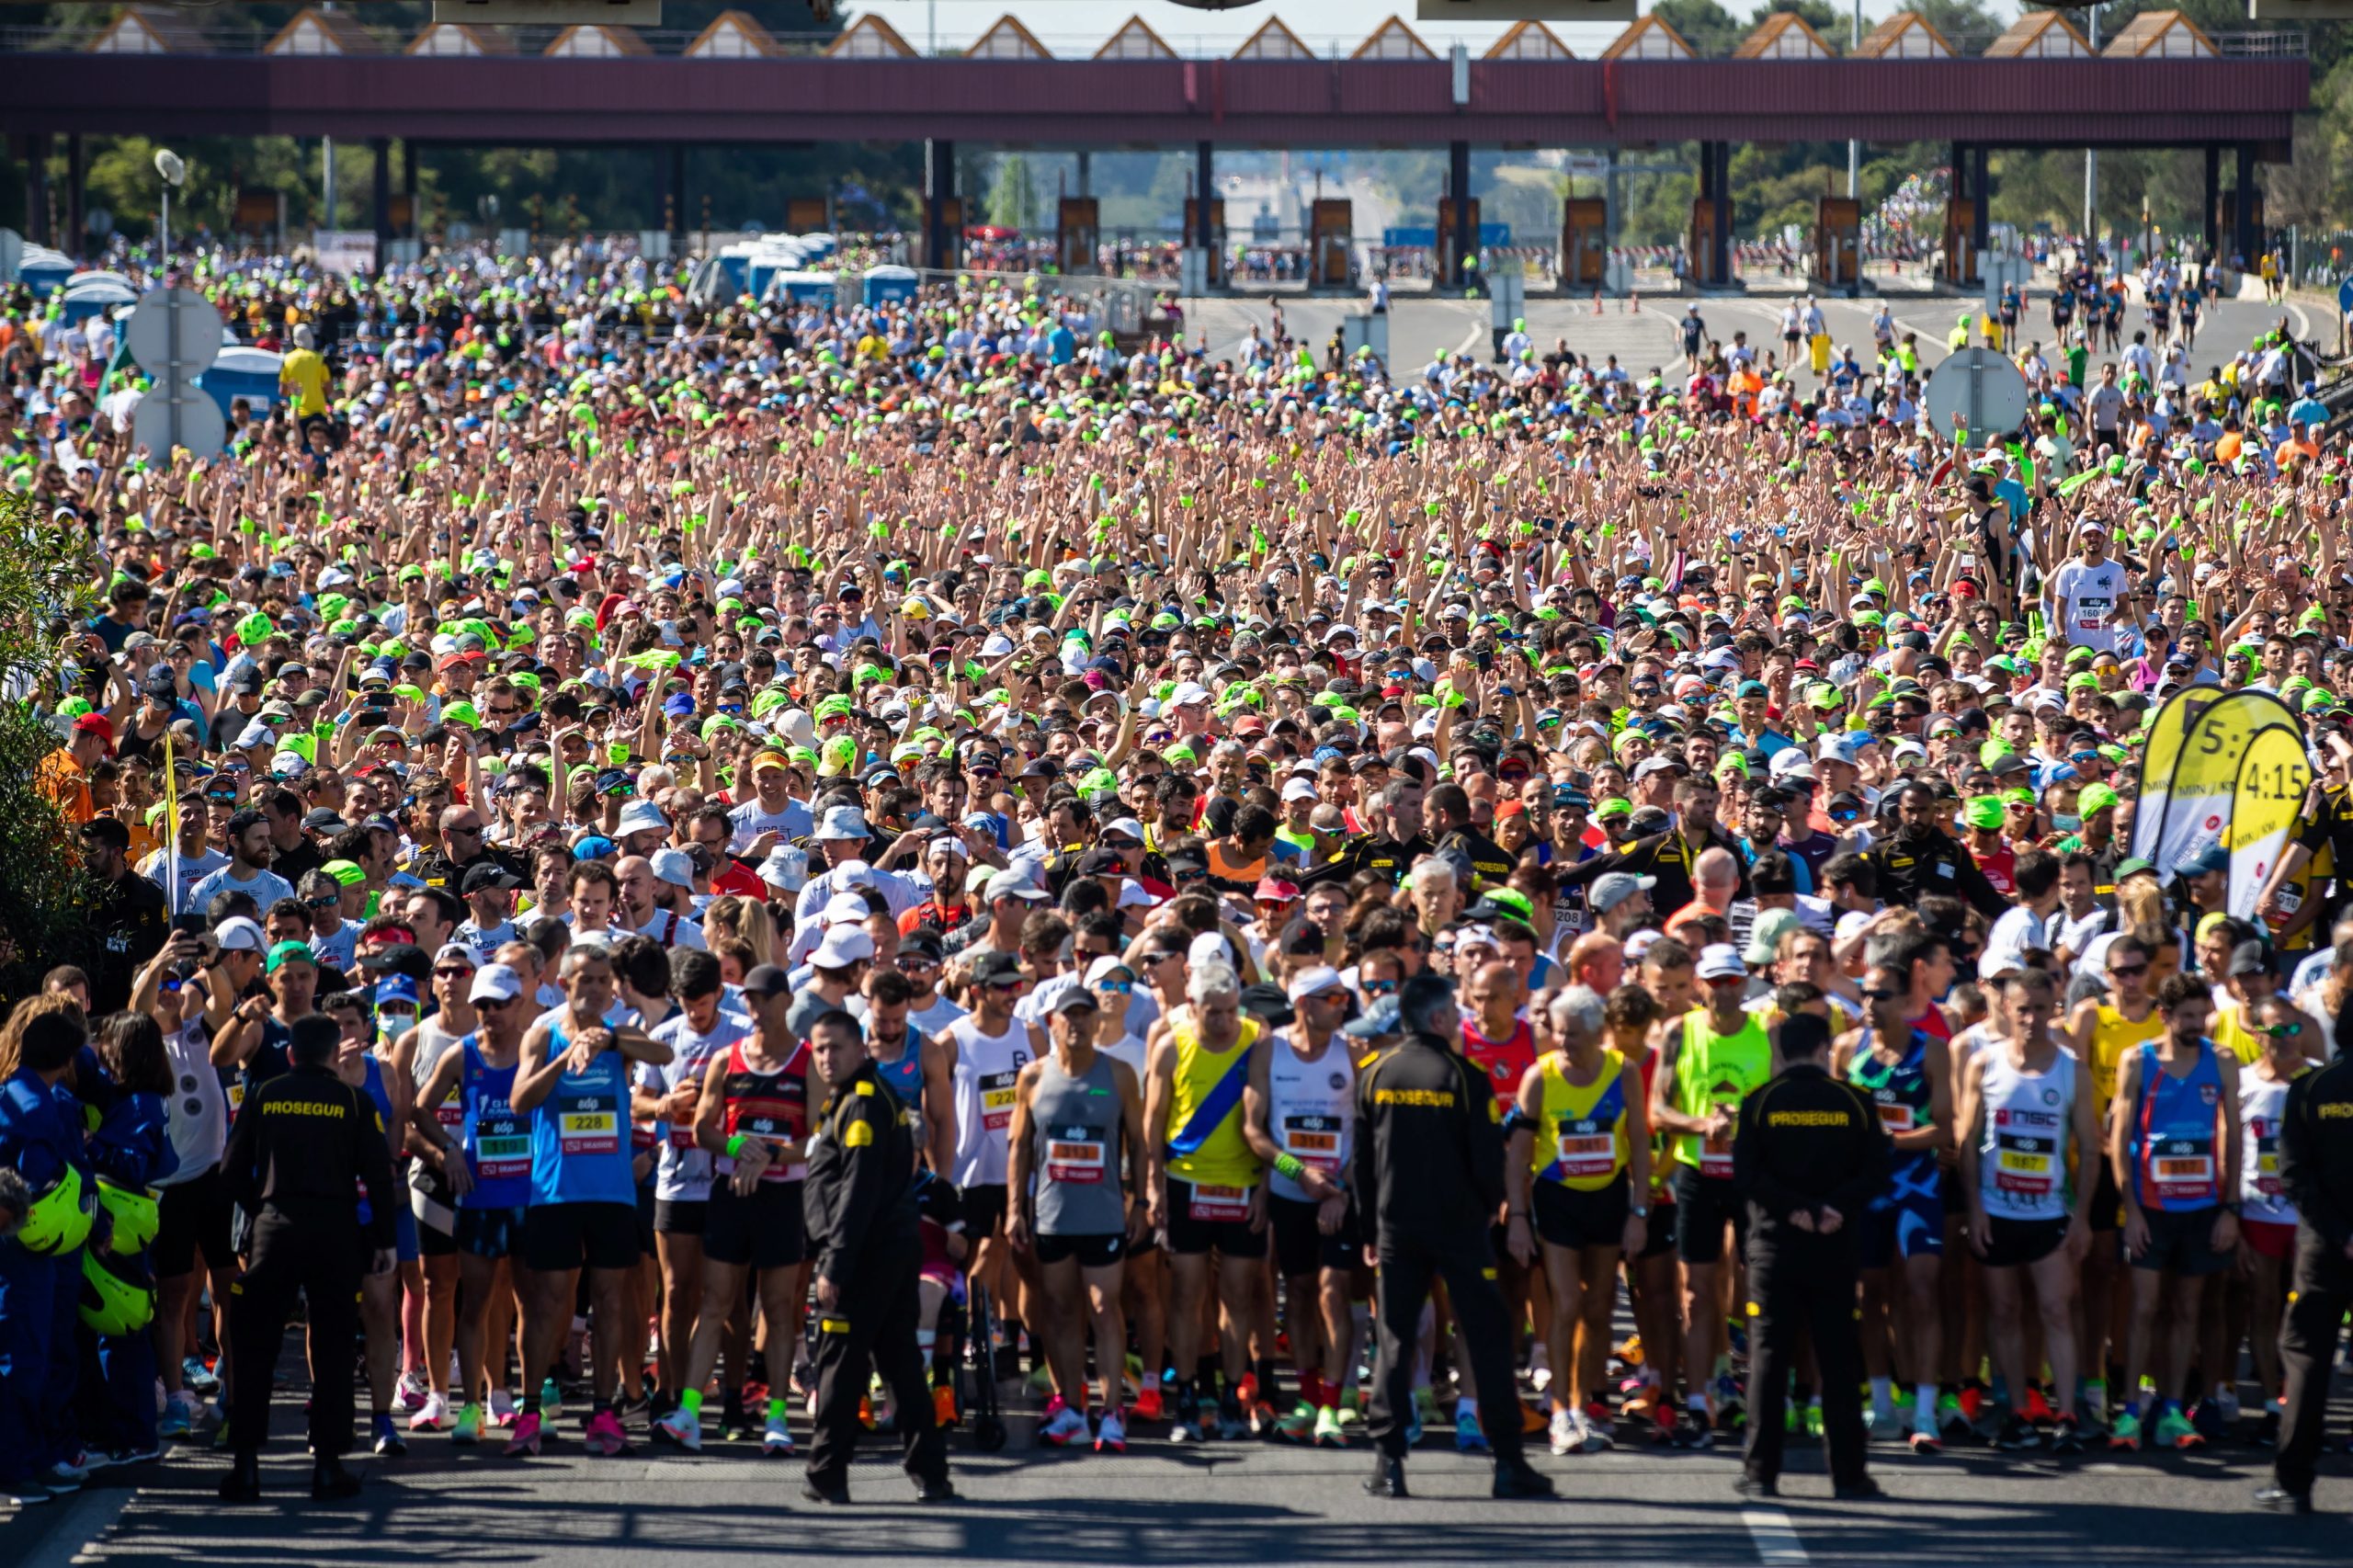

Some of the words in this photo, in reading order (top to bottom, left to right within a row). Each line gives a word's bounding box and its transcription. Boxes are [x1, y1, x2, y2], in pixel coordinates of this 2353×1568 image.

[2200, 719, 2257, 759] 5:
[2178, 784, 2206, 796] MIN
[2245, 763, 2305, 801] 4:15
[180, 869, 200, 878] EDP
[576, 1096, 600, 1111] edp
[1374, 1088, 1455, 1108] PROSEGUR
[263, 1100, 346, 1119] PROSEGUR
[575, 1115, 603, 1131] 228
[753, 1118, 774, 1134] edp
[1302, 1117, 1324, 1131] edp
[1768, 1110, 1849, 1128] PROSEGUR
[493, 1121, 515, 1135] edp
[1574, 1120, 1597, 1135] edp
